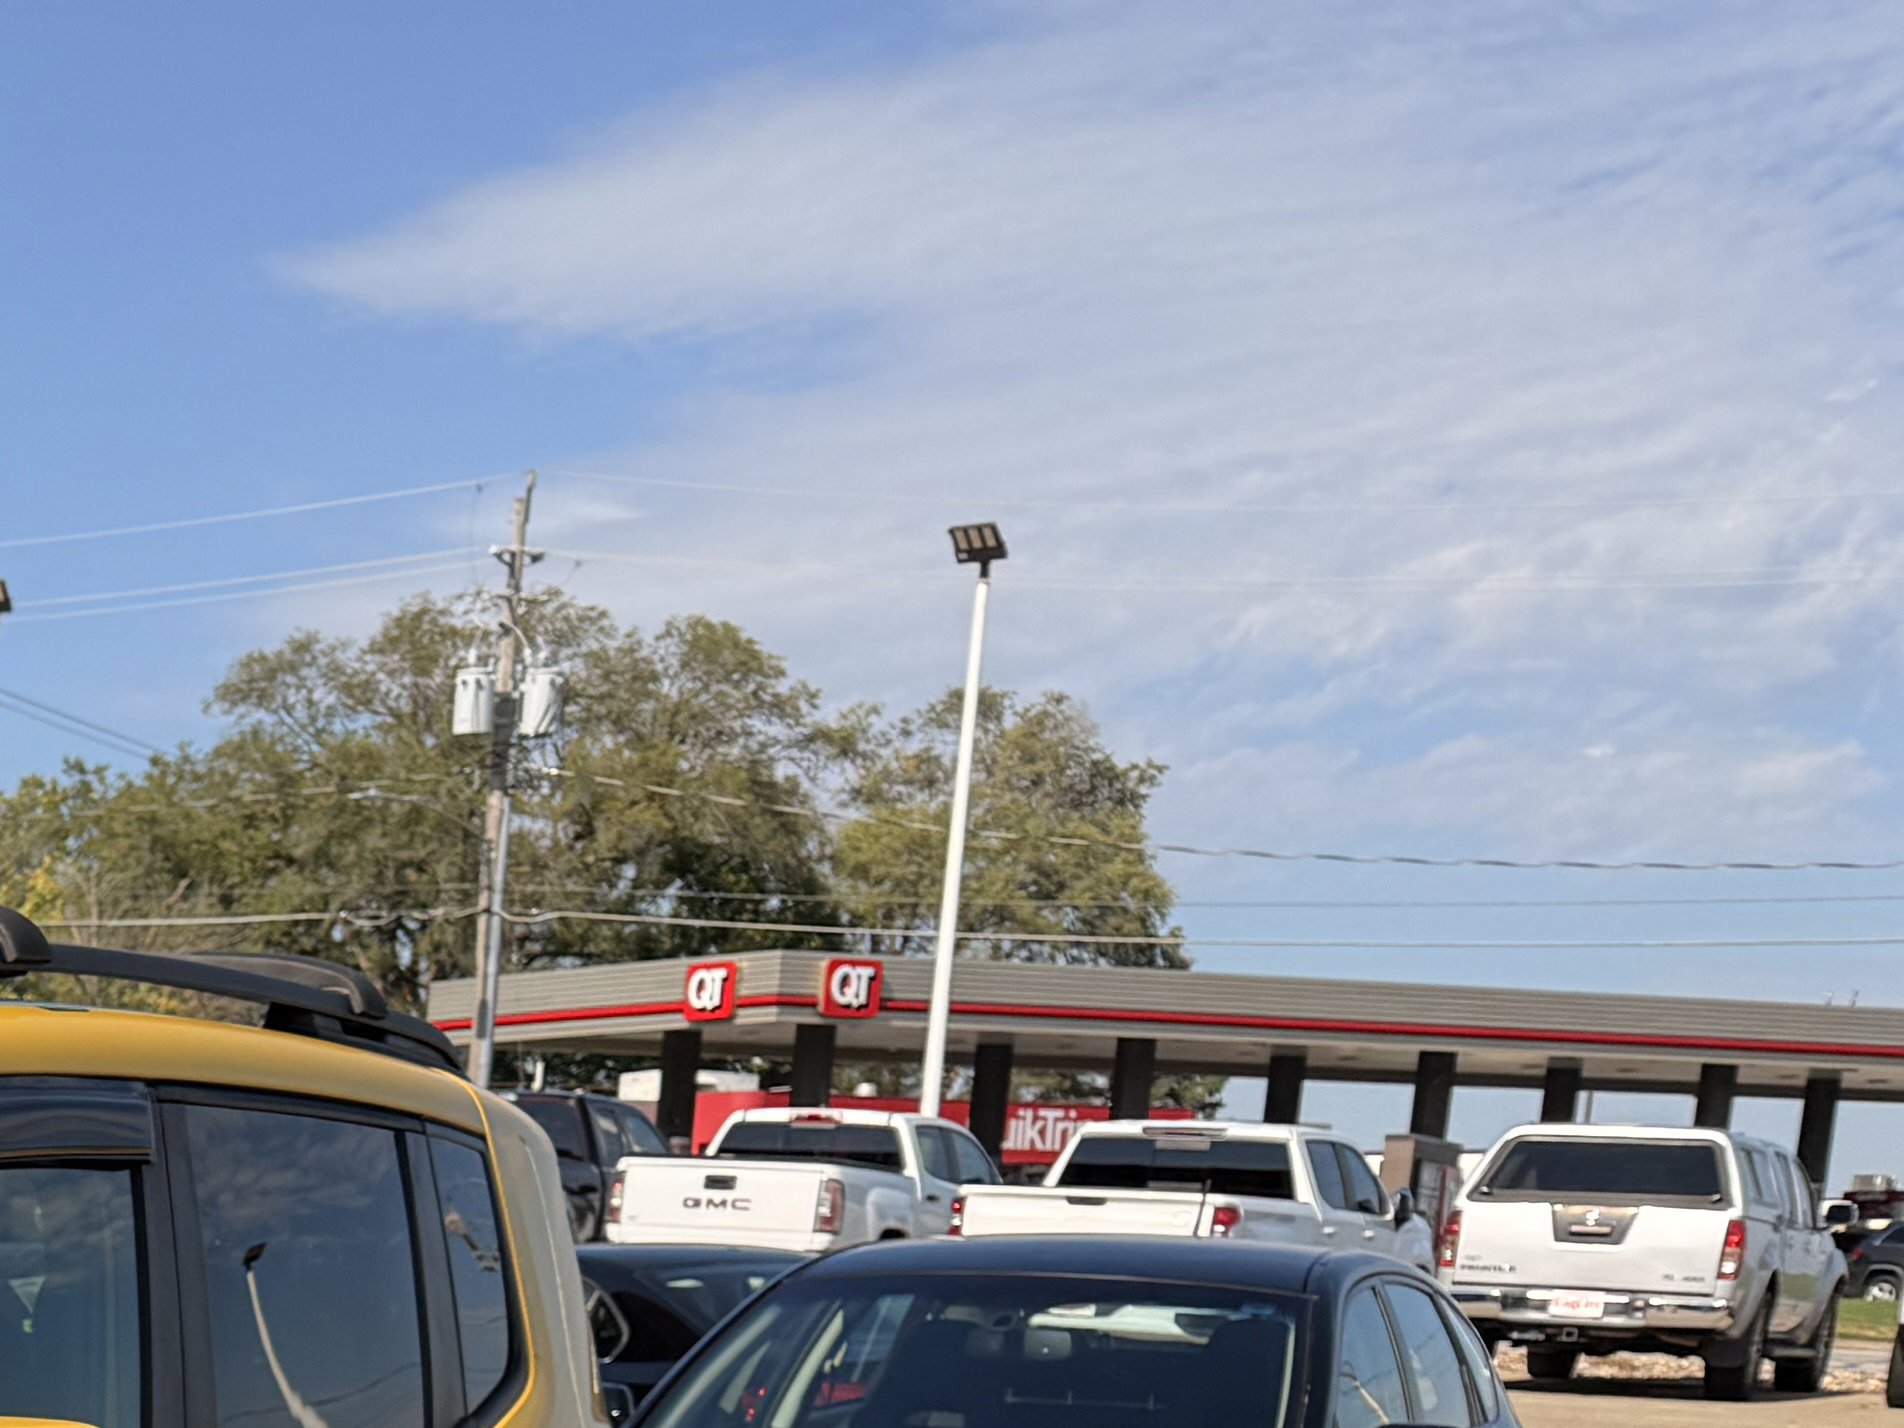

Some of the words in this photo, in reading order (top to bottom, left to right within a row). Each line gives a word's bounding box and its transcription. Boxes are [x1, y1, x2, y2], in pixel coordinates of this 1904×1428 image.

[688, 967, 728, 1010] QT
[831, 963, 876, 1008] QT
[683, 1197, 751, 1211] GMC
